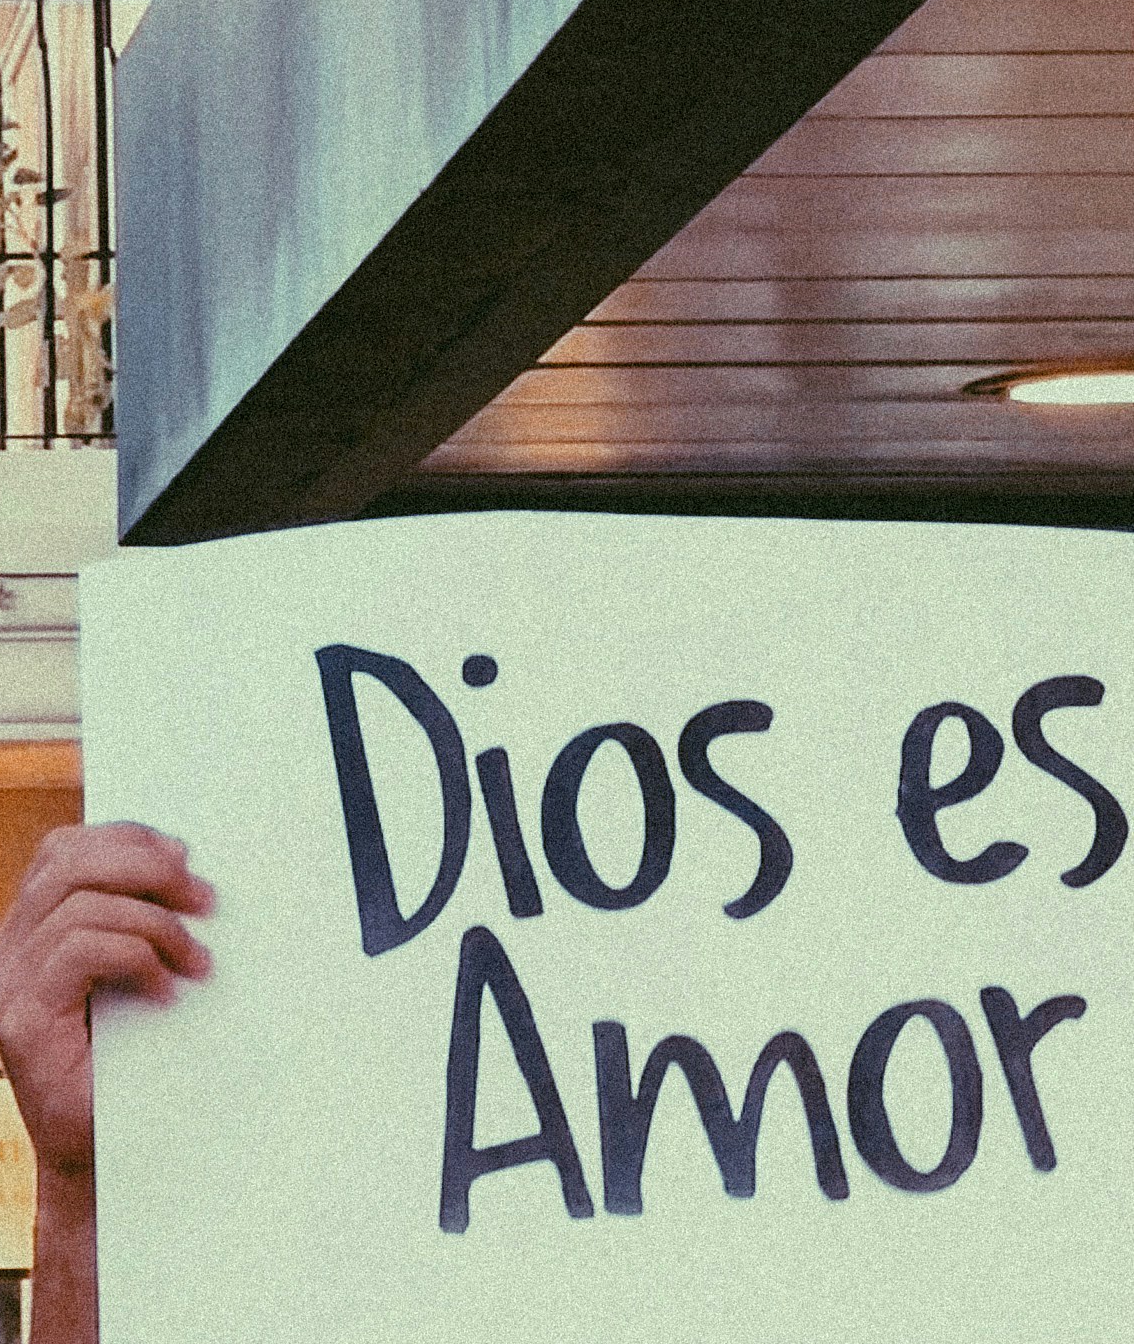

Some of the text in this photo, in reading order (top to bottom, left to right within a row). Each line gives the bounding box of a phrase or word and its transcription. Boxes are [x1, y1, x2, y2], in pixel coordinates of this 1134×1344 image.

[314, 643, 1130, 958] Dios es
[438, 924, 1089, 1235] Amor
